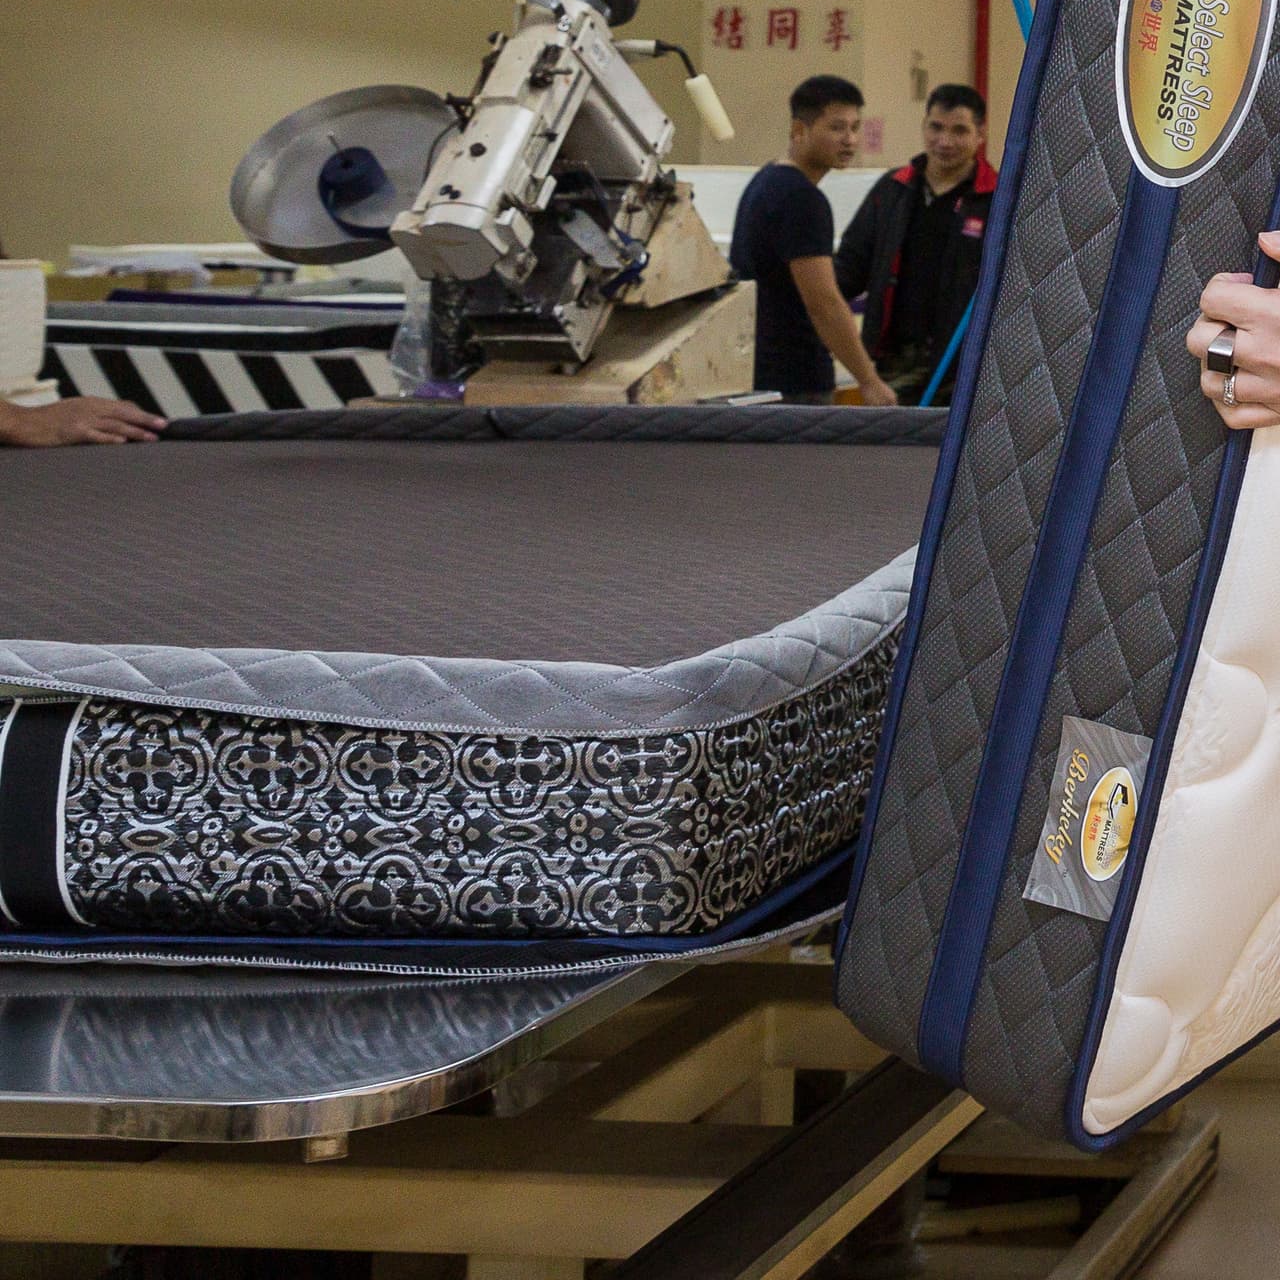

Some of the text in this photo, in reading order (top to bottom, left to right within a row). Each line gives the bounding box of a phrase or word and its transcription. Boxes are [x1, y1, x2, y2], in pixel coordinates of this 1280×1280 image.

[1163, 79, 1214, 153] Sleep
[1044, 748, 1090, 865] Berkeley
[1095, 819, 1112, 863] MATTRESS
